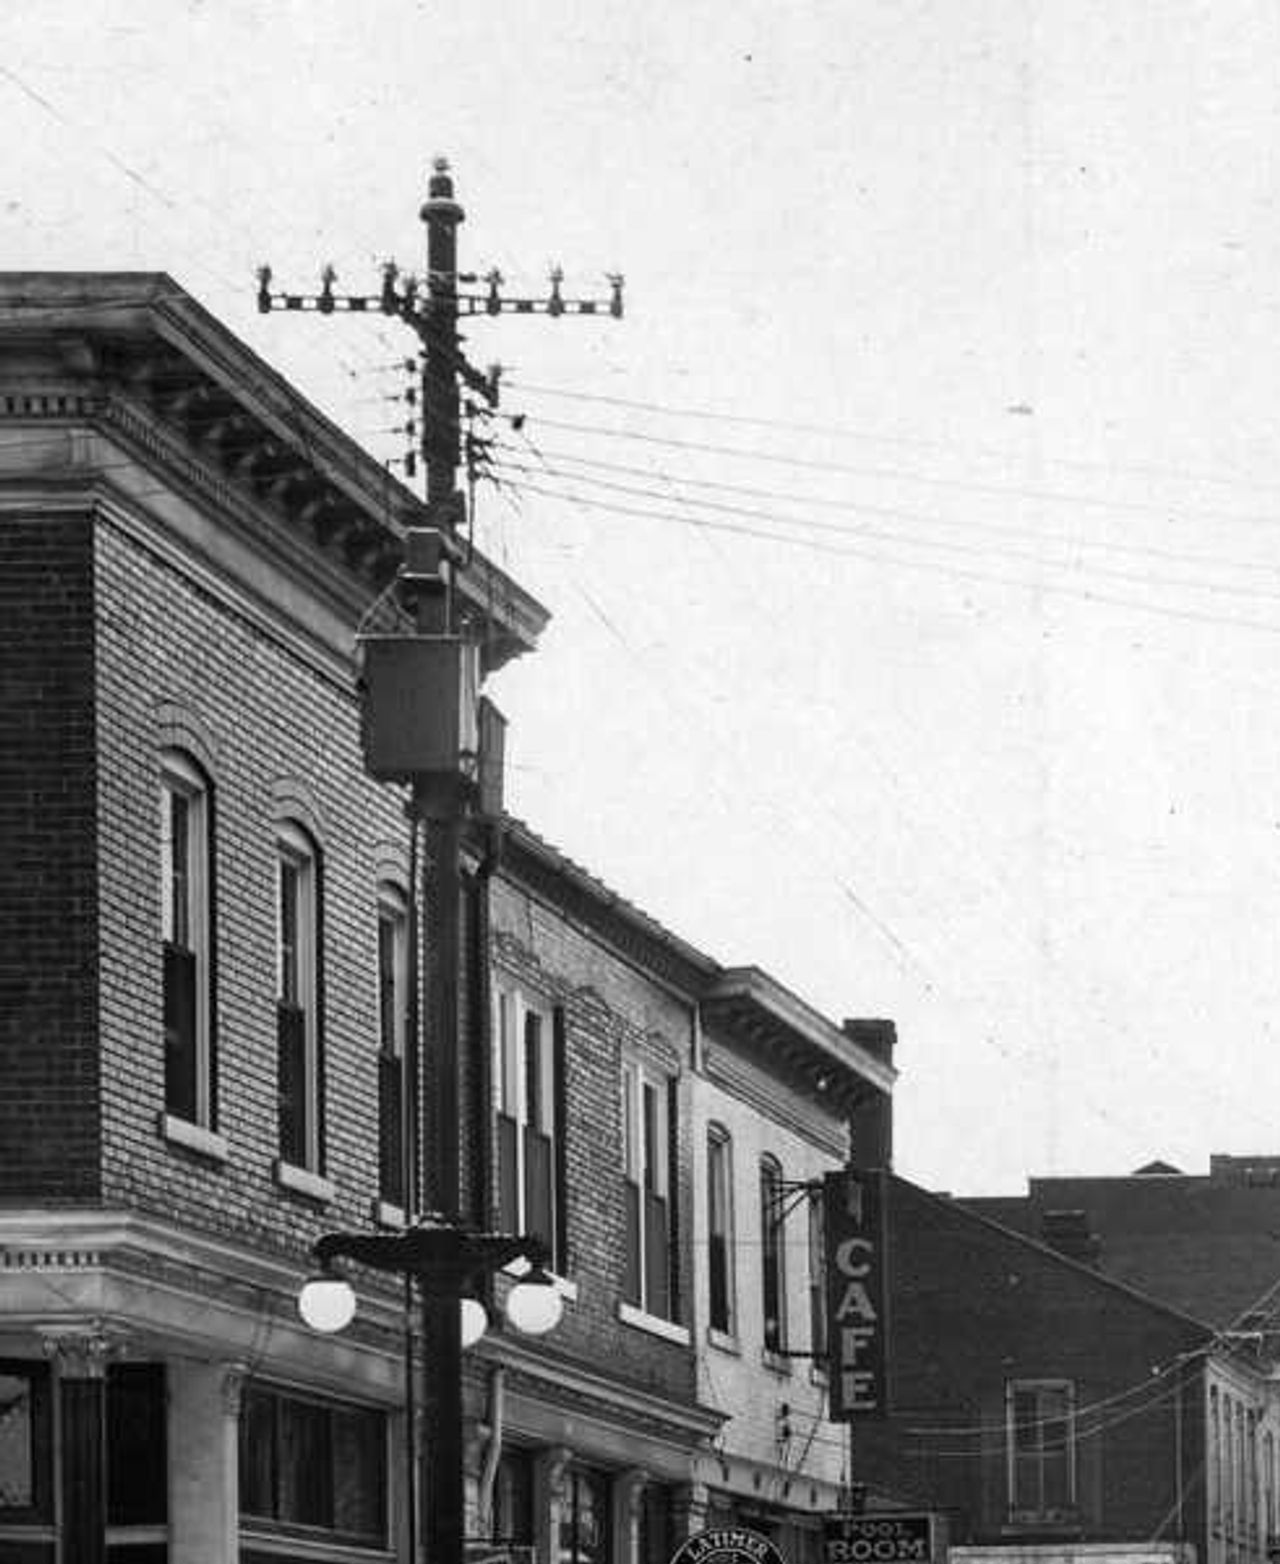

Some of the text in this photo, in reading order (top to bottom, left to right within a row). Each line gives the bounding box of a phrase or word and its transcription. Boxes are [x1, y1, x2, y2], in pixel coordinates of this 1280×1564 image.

[835, 1237, 878, 1410] CAFE
[687, 1531, 769, 1560] LATIMER
[827, 1539, 926, 1561] ROOM
